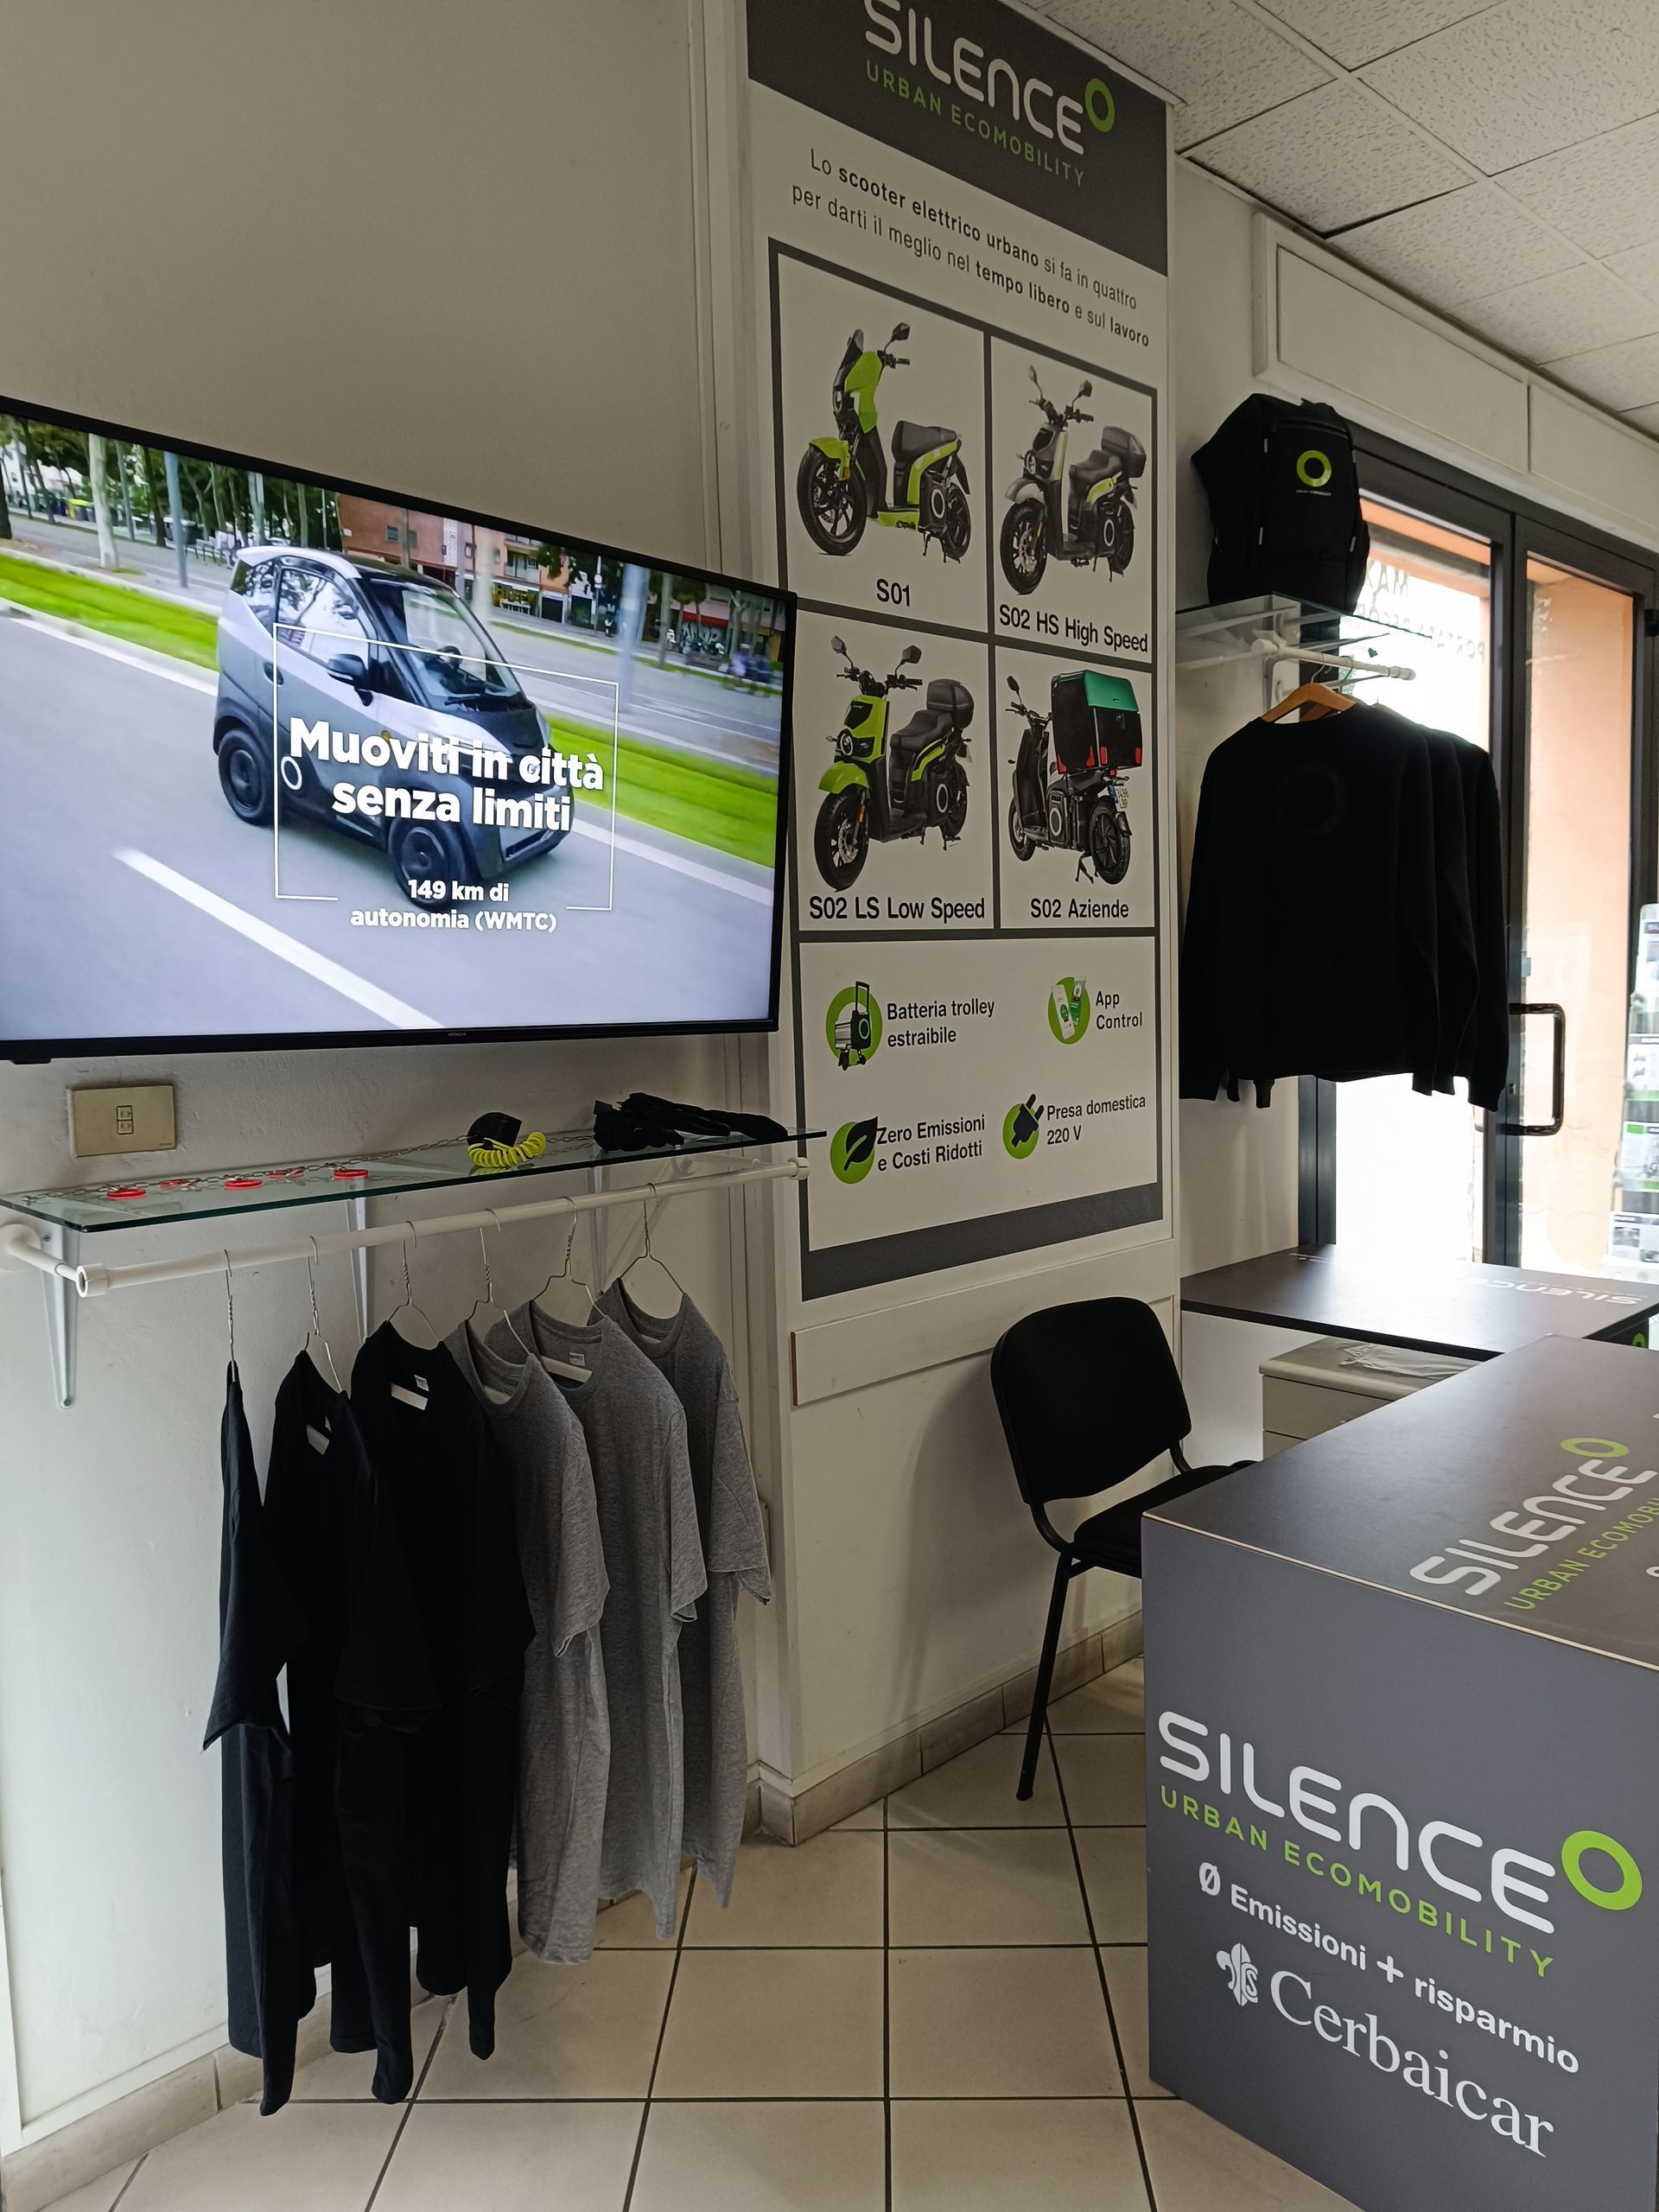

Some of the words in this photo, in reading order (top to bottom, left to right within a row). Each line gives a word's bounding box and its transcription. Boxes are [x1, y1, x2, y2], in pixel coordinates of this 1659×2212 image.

[867, 60, 942, 116] URBAN
[951, 106, 1084, 187] ECOMOBILITY
[811, 149, 831, 175] Lo
[838, 167, 906, 208] scooter
[912, 199, 981, 241] elettrico
[987, 232, 1039, 267] urbano
[1044, 257, 1056, 275] si
[1060, 261, 1072, 282] fa
[1077, 268, 1089, 289] in
[1093, 276, 1138, 310] quattro
[792, 184, 821, 211] per
[828, 198, 868, 231] darti
[873, 214, 883, 237] il
[888, 226, 942, 263] meglio
[947, 248, 970, 273] nel
[976, 260, 1024, 295] tempo
[1028, 283, 1071, 315] libero
[1075, 305, 1084, 320] e
[1087, 308, 1106, 329] sul
[1110, 316, 1149, 347] lavoro
[876, 577, 911, 607] S01
[999, 604, 1031, 630] S02
[1036, 611, 1059, 635] HS
[1065, 617, 1098, 646] High
[1103, 626, 1148, 652] Speed
[289, 716, 460, 775] Muoviti
[472, 739, 509, 780] in
[518, 746, 604, 791] città
[332, 779, 461, 823] senza
[473, 786, 572, 831] limiti
[408, 879, 447, 899] 149
[451, 881, 484, 902] km
[489, 882, 510, 903] di
[350, 908, 470, 930] autonomia
[475, 910, 557, 933] (WMTC)
[809, 895, 848, 919] S02
[855, 896, 880, 919] LS
[887, 896, 925, 919] Low
[931, 897, 985, 924] Speed
[1030, 898, 1062, 918] S02
[1068, 898, 1129, 918] Aziende
[887, 1000, 947, 1020] Batteria
[950, 998, 995, 1019] trolley
[1096, 990, 1120, 1009] App
[887, 1026, 957, 1047] estraibile
[1096, 1011, 1143, 1030] Control
[1046, 1103, 1083, 1121] Presa
[1086, 1094, 1147, 1116] domestica
[876, 1124, 912, 1144] Zero
[917, 1114, 985, 1139] Emissioni
[1046, 1128, 1070, 1146] 220
[1072, 1125, 1082, 1141] V
[877, 1157, 887, 1172] e
[892, 1147, 931, 1169] Costi
[936, 1139, 982, 1163] Ridotti
[1409, 1459, 1658, 1596] SILENCE
[1503, 1558, 1591, 1611] URBAN
[1159, 1711, 1555, 1935] SILENCE
[1160, 1784, 1268, 1852] URBAN
[1284, 1840, 1554, 1977] ECOMOBILITY
[1231, 1884, 1366, 1971] Emissioni
[1415, 1976, 1580, 2074] risparmio
[1270, 1970, 1554, 2158] Cerbaicar
